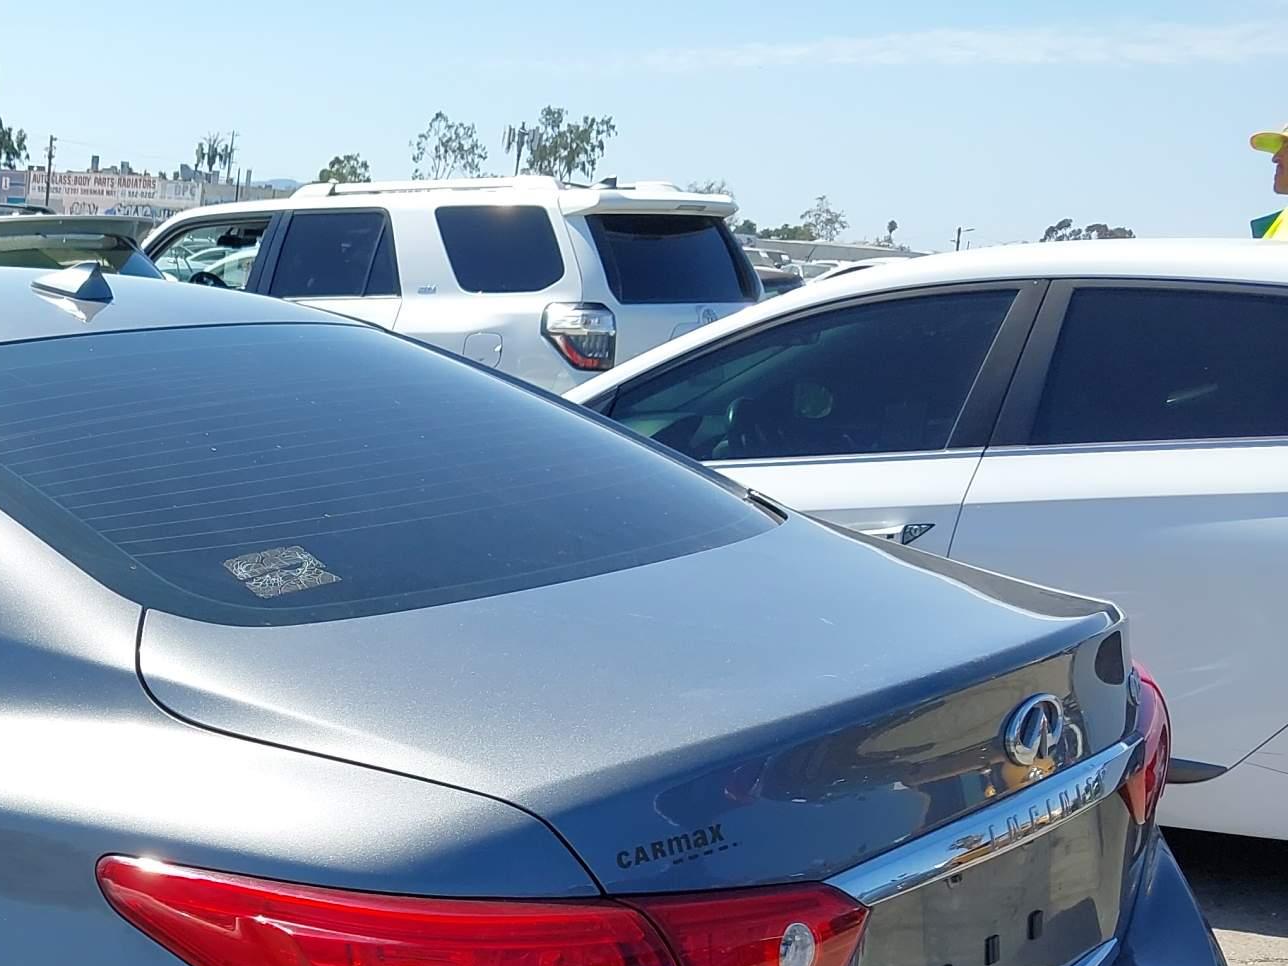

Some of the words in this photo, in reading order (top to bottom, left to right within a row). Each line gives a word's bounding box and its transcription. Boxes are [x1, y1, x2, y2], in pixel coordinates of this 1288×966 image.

[32, 173, 49, 185] AUTO
[74, 175, 91, 187] BODY
[94, 176, 114, 188] PARTS
[118, 177, 156, 190] RADIATORS
